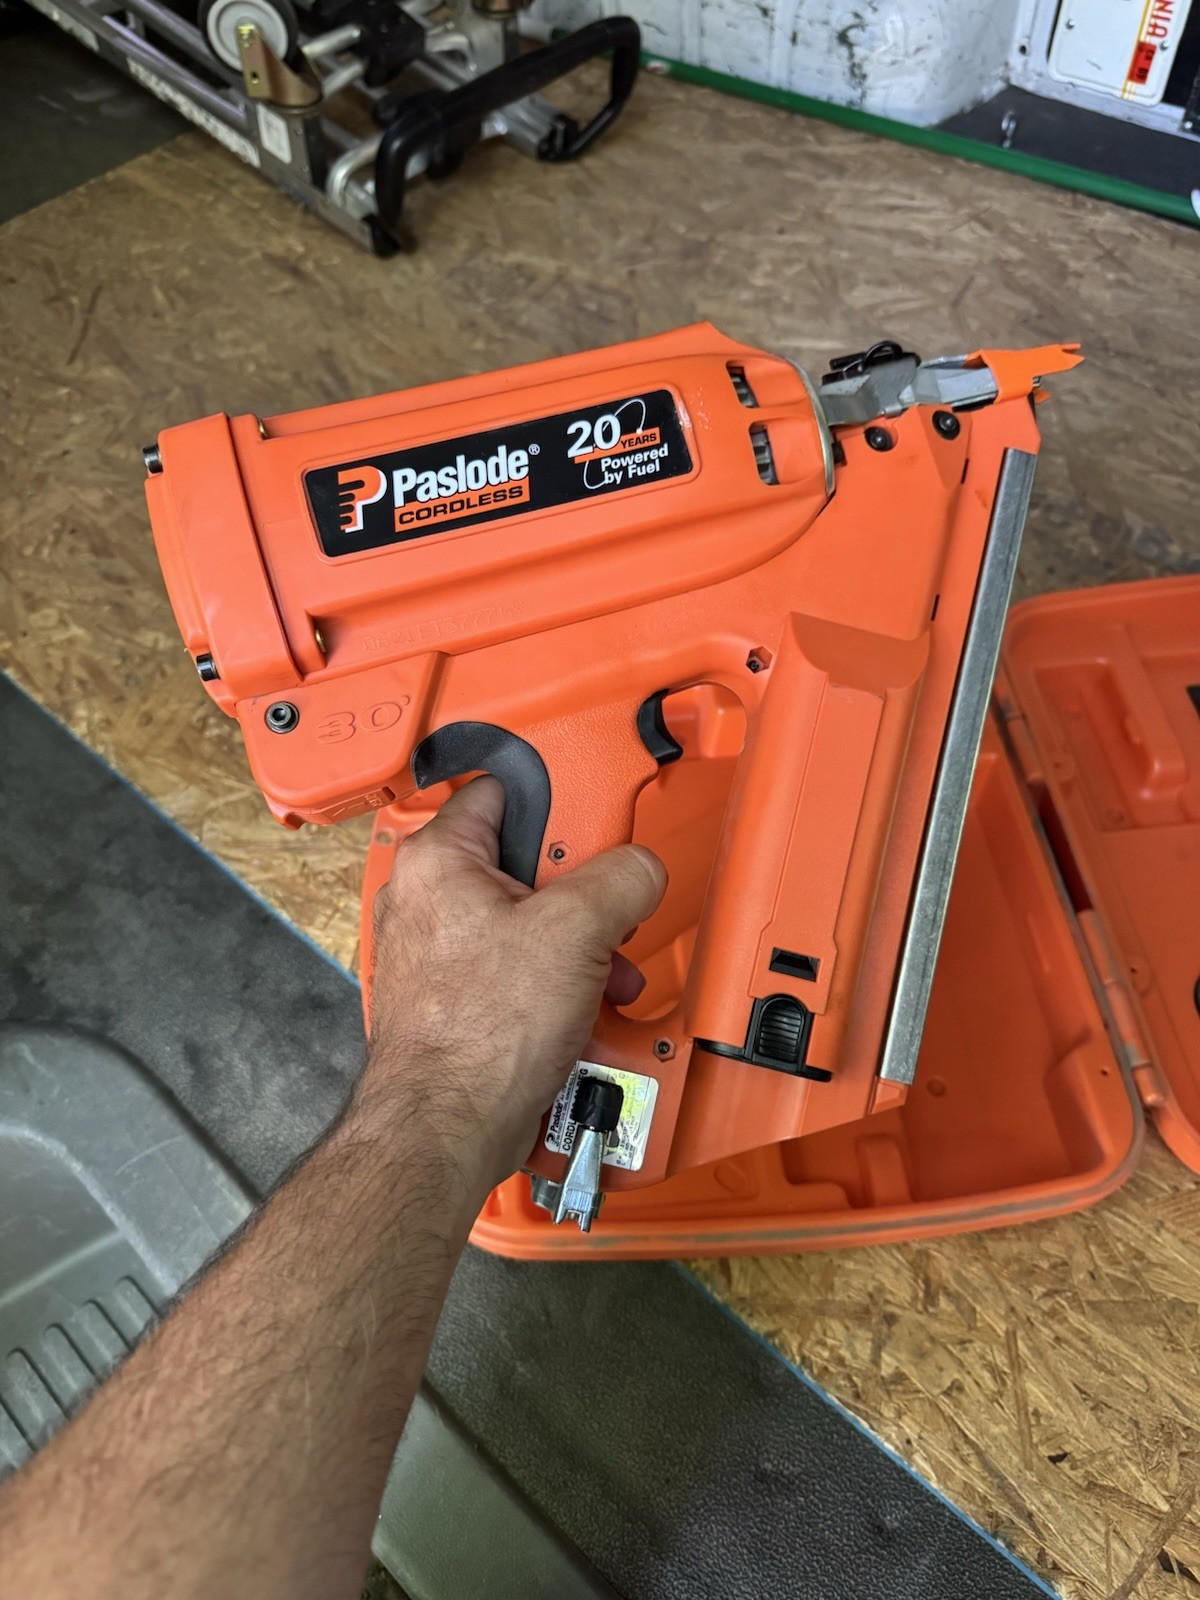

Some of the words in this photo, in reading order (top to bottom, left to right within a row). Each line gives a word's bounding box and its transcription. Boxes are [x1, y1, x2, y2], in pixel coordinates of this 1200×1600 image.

[566, 414, 621, 459] 20
[620, 431, 657, 449] YEARS
[600, 443, 669, 472] Powered
[604, 469, 625, 486] by
[627, 459, 661, 480] Fuel
[398, 485, 524, 526] CORDLESS
[562, 1102, 578, 1151] CORDL
